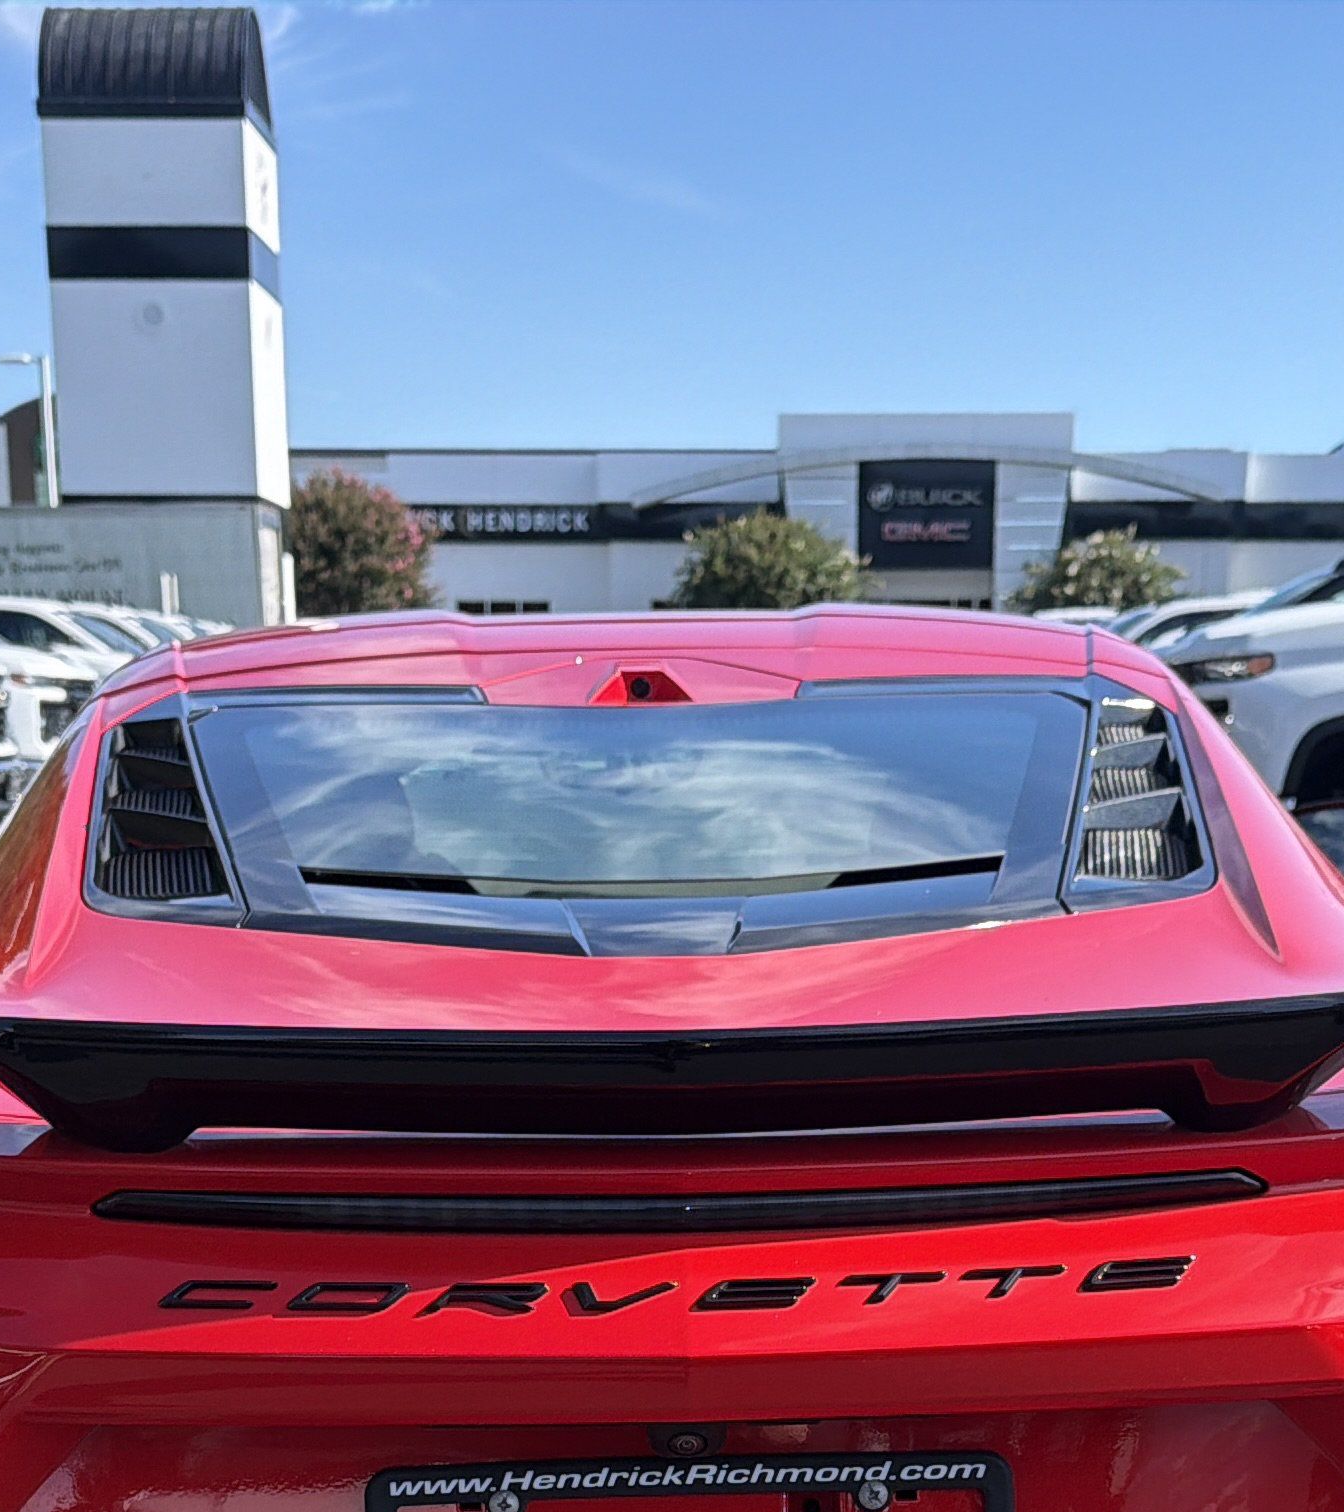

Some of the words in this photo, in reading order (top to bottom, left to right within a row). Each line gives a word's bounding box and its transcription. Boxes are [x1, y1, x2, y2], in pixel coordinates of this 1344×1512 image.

[466, 508, 590, 533] HENDRICK
[156, 1253, 1197, 1319] CORVETTE
[389, 1461, 986, 1497] www.HendrickRichmond.com
